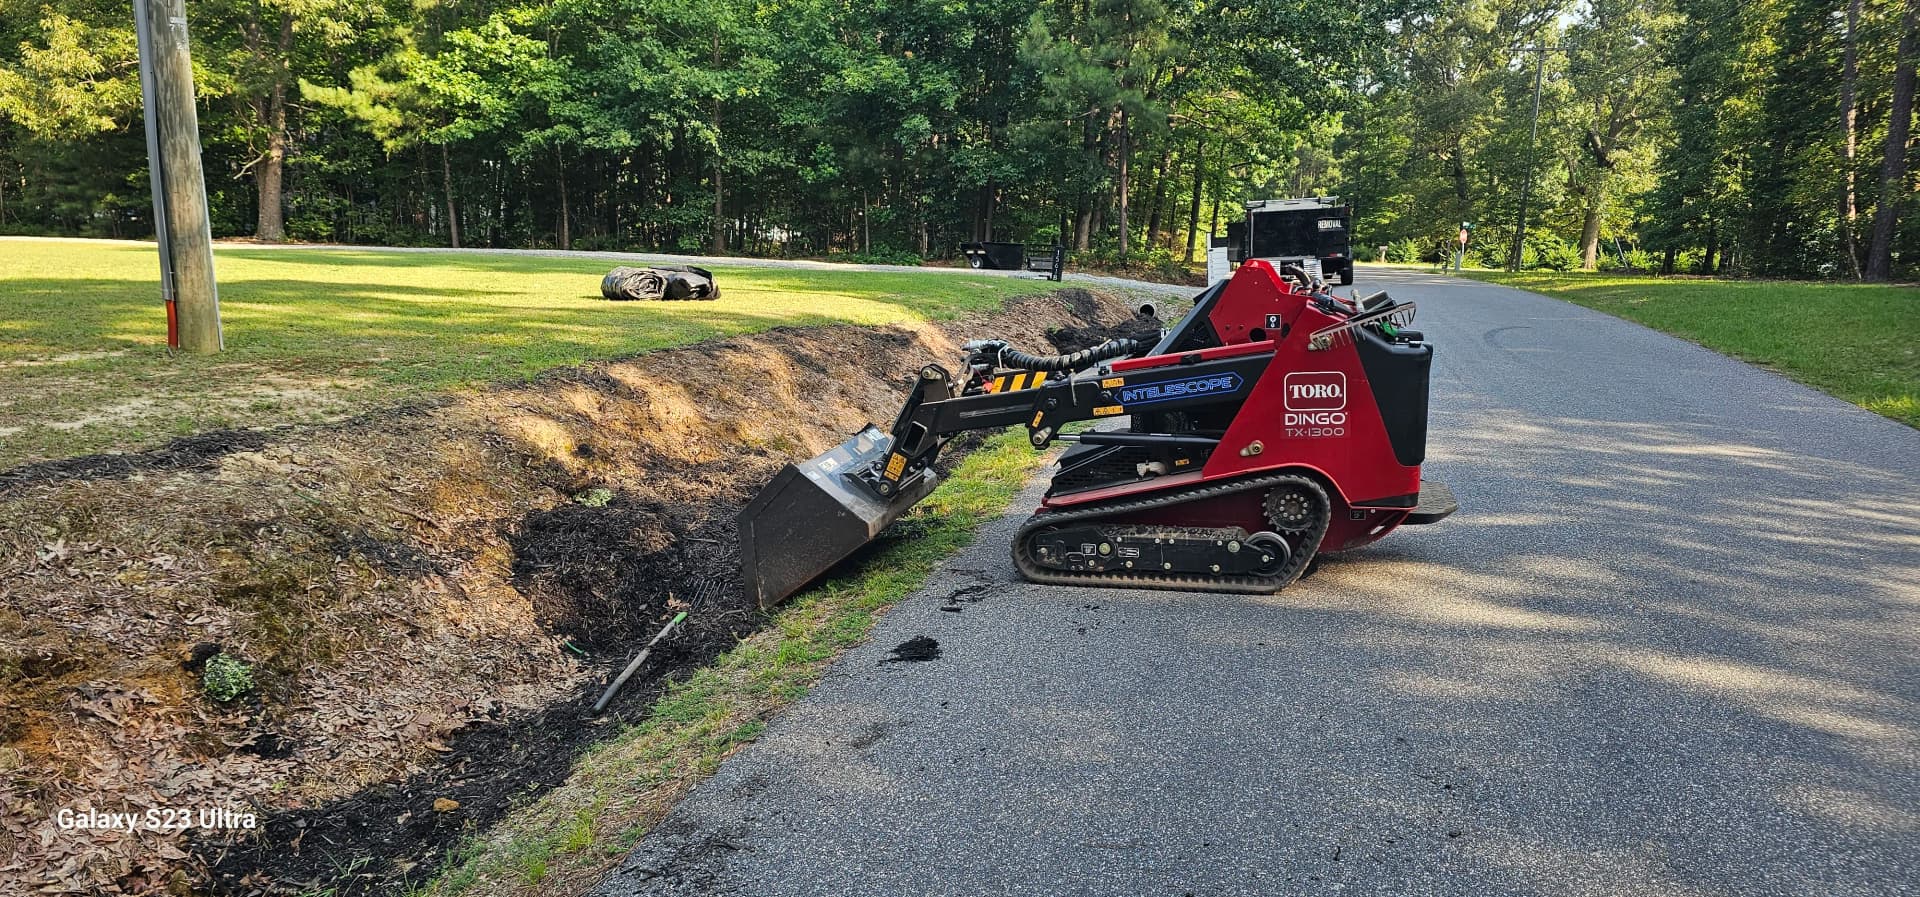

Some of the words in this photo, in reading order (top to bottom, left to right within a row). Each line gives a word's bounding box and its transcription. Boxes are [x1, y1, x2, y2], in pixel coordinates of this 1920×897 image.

[1317, 219, 1343, 229] REMOVAL
[1122, 376, 1233, 402] INTELESCOPE
[1289, 383, 1341, 399] TORO
[1284, 412, 1346, 426] DINGO
